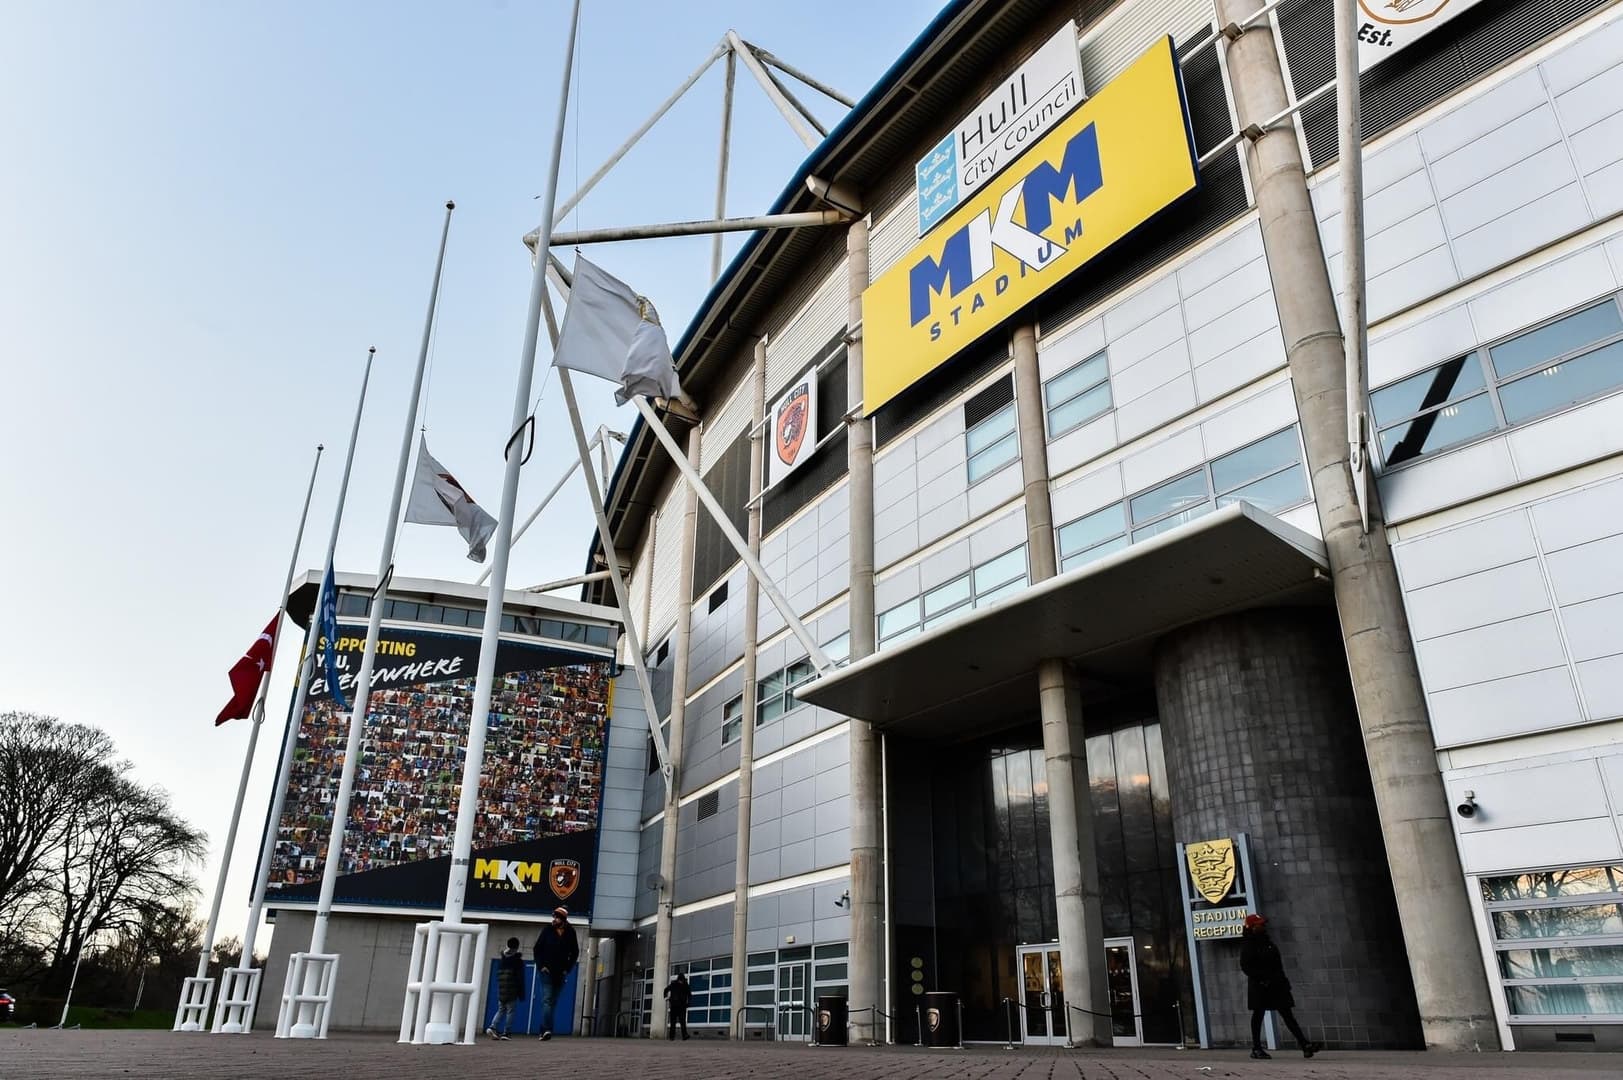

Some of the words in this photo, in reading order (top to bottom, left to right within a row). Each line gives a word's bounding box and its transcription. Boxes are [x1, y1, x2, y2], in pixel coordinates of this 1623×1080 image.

[1357, 23, 1393, 47] Est.
[961, 73, 1027, 160] Hull
[964, 149, 997, 186] City
[1004, 77, 1076, 151] Council
[909, 120, 1104, 328] MKM
[930, 218, 1083, 342] STADIUM
[316, 653, 350, 671] YU,
[474, 858, 541, 892] MKM
[1193, 908, 1247, 923] STADIUM
[1193, 924, 1244, 937] RECEPTIO
